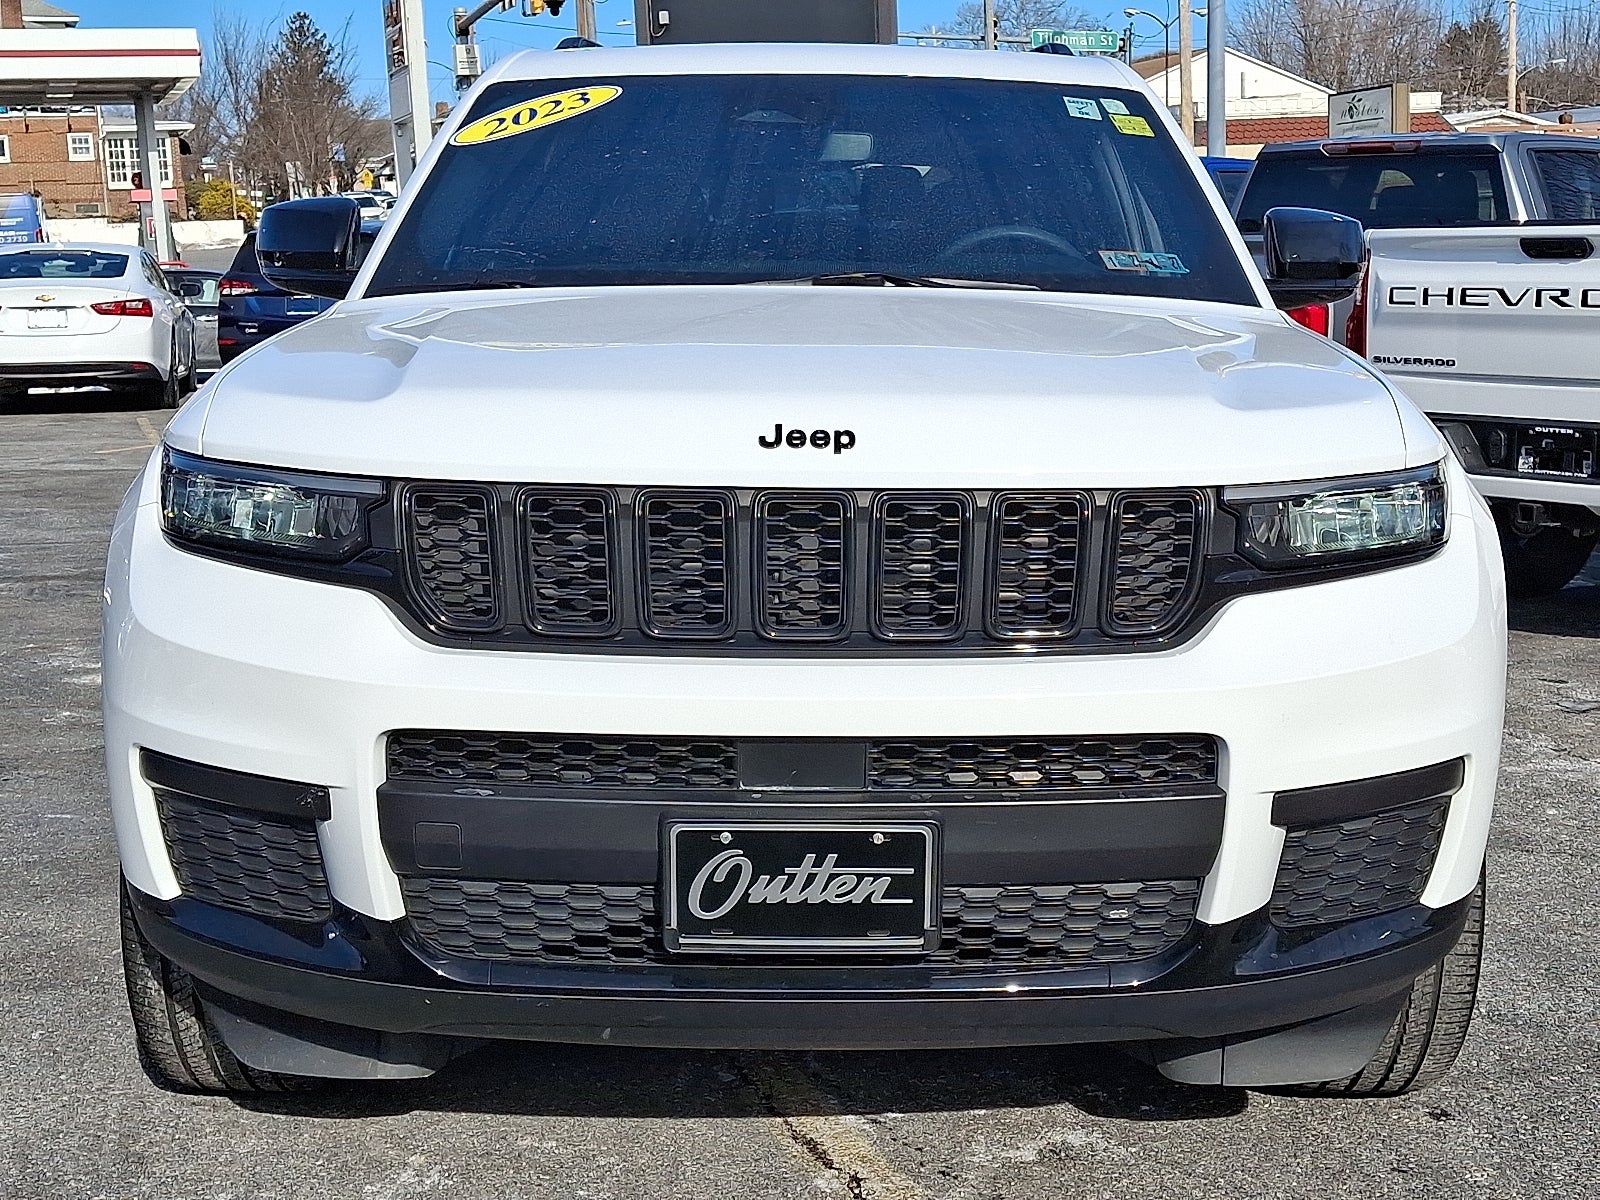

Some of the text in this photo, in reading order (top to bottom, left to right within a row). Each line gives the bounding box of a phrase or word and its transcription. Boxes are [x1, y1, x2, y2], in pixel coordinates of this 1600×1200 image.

[1100, 35, 1113, 46] St
[483, 92, 591, 138] 2023
[1372, 355, 1456, 367] SILVERADO
[758, 423, 856, 455] Jeep
[1534, 426, 1574, 434] OUTTEN
[687, 849, 914, 920] Outten
